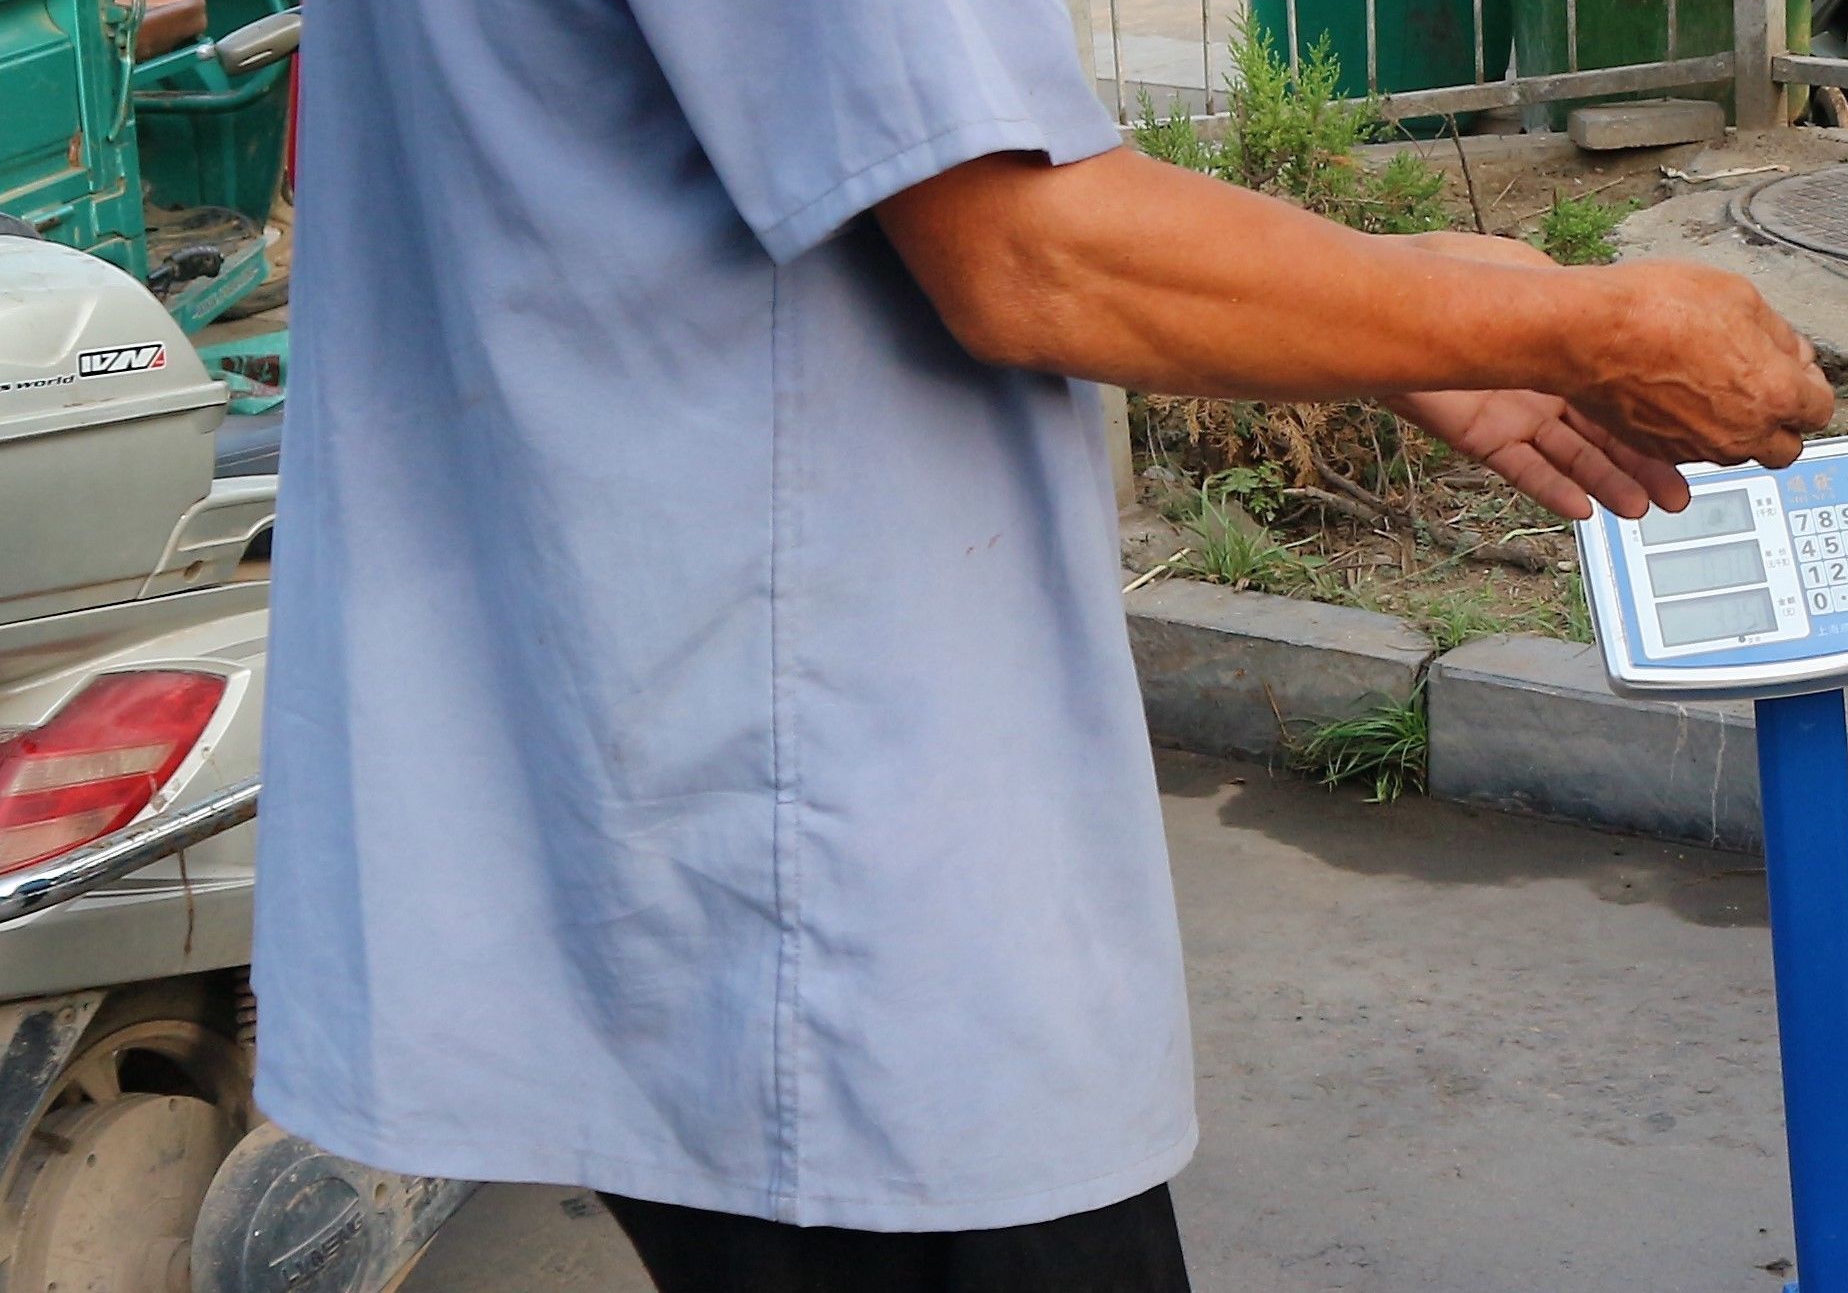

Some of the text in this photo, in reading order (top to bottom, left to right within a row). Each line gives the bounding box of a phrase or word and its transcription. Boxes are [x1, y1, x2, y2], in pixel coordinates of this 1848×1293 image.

[17, 374, 76, 390] world
[1795, 513, 1808, 532] 7
[1818, 510, 1834, 528] 8
[1801, 539, 1815, 557] 4
[1824, 536, 1839, 554] 5
[1808, 566, 1821, 583] 1
[1830, 562, 1847, 581] 2
[1813, 592, 1828, 610] 0
